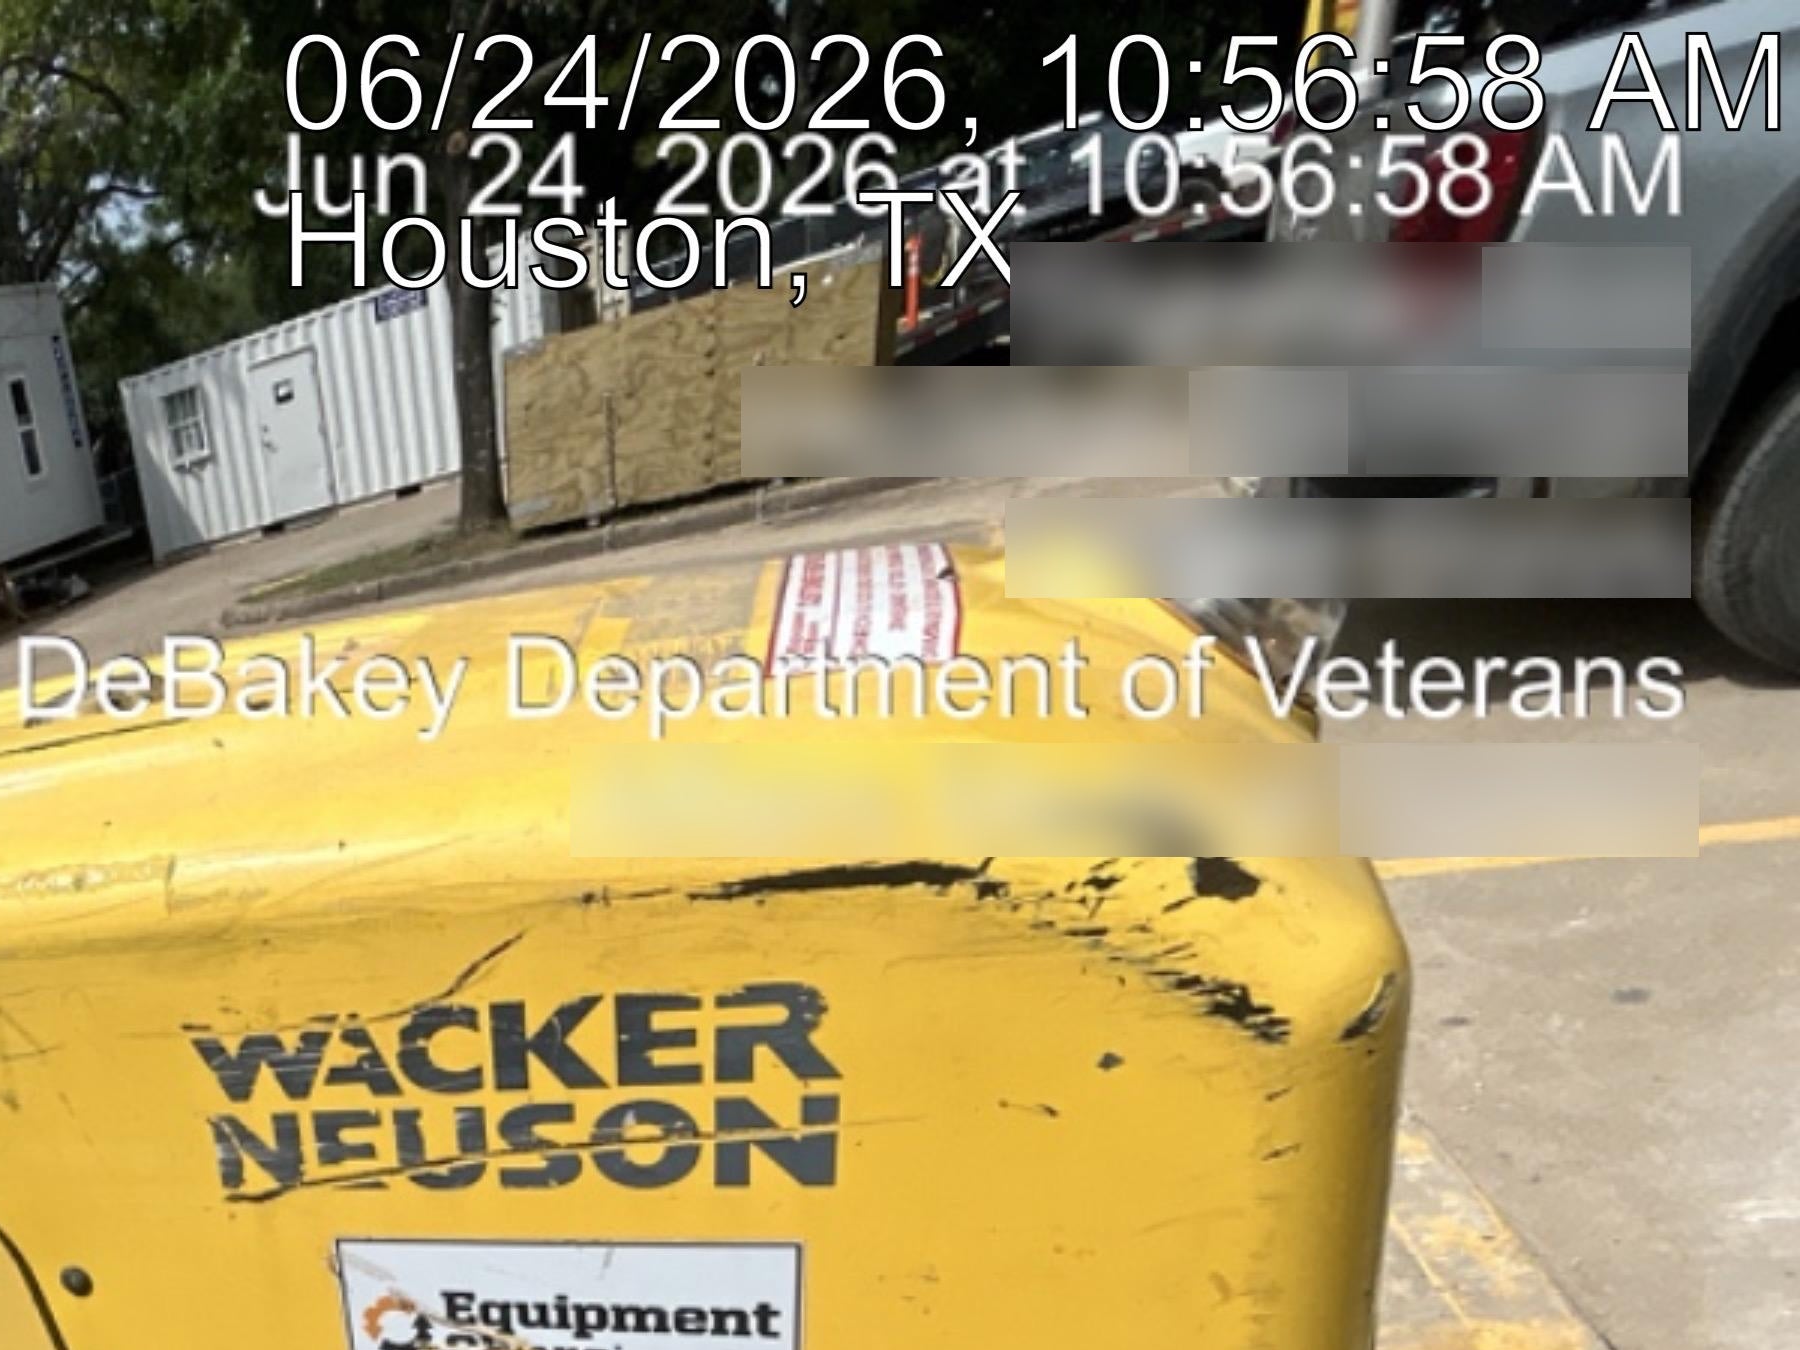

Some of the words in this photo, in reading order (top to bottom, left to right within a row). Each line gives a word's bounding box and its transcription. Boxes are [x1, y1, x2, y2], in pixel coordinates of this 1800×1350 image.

[190, 982, 844, 1101] WACKER
[206, 1093, 841, 1190] NEUSON
[440, 1291, 780, 1340] Equipment
